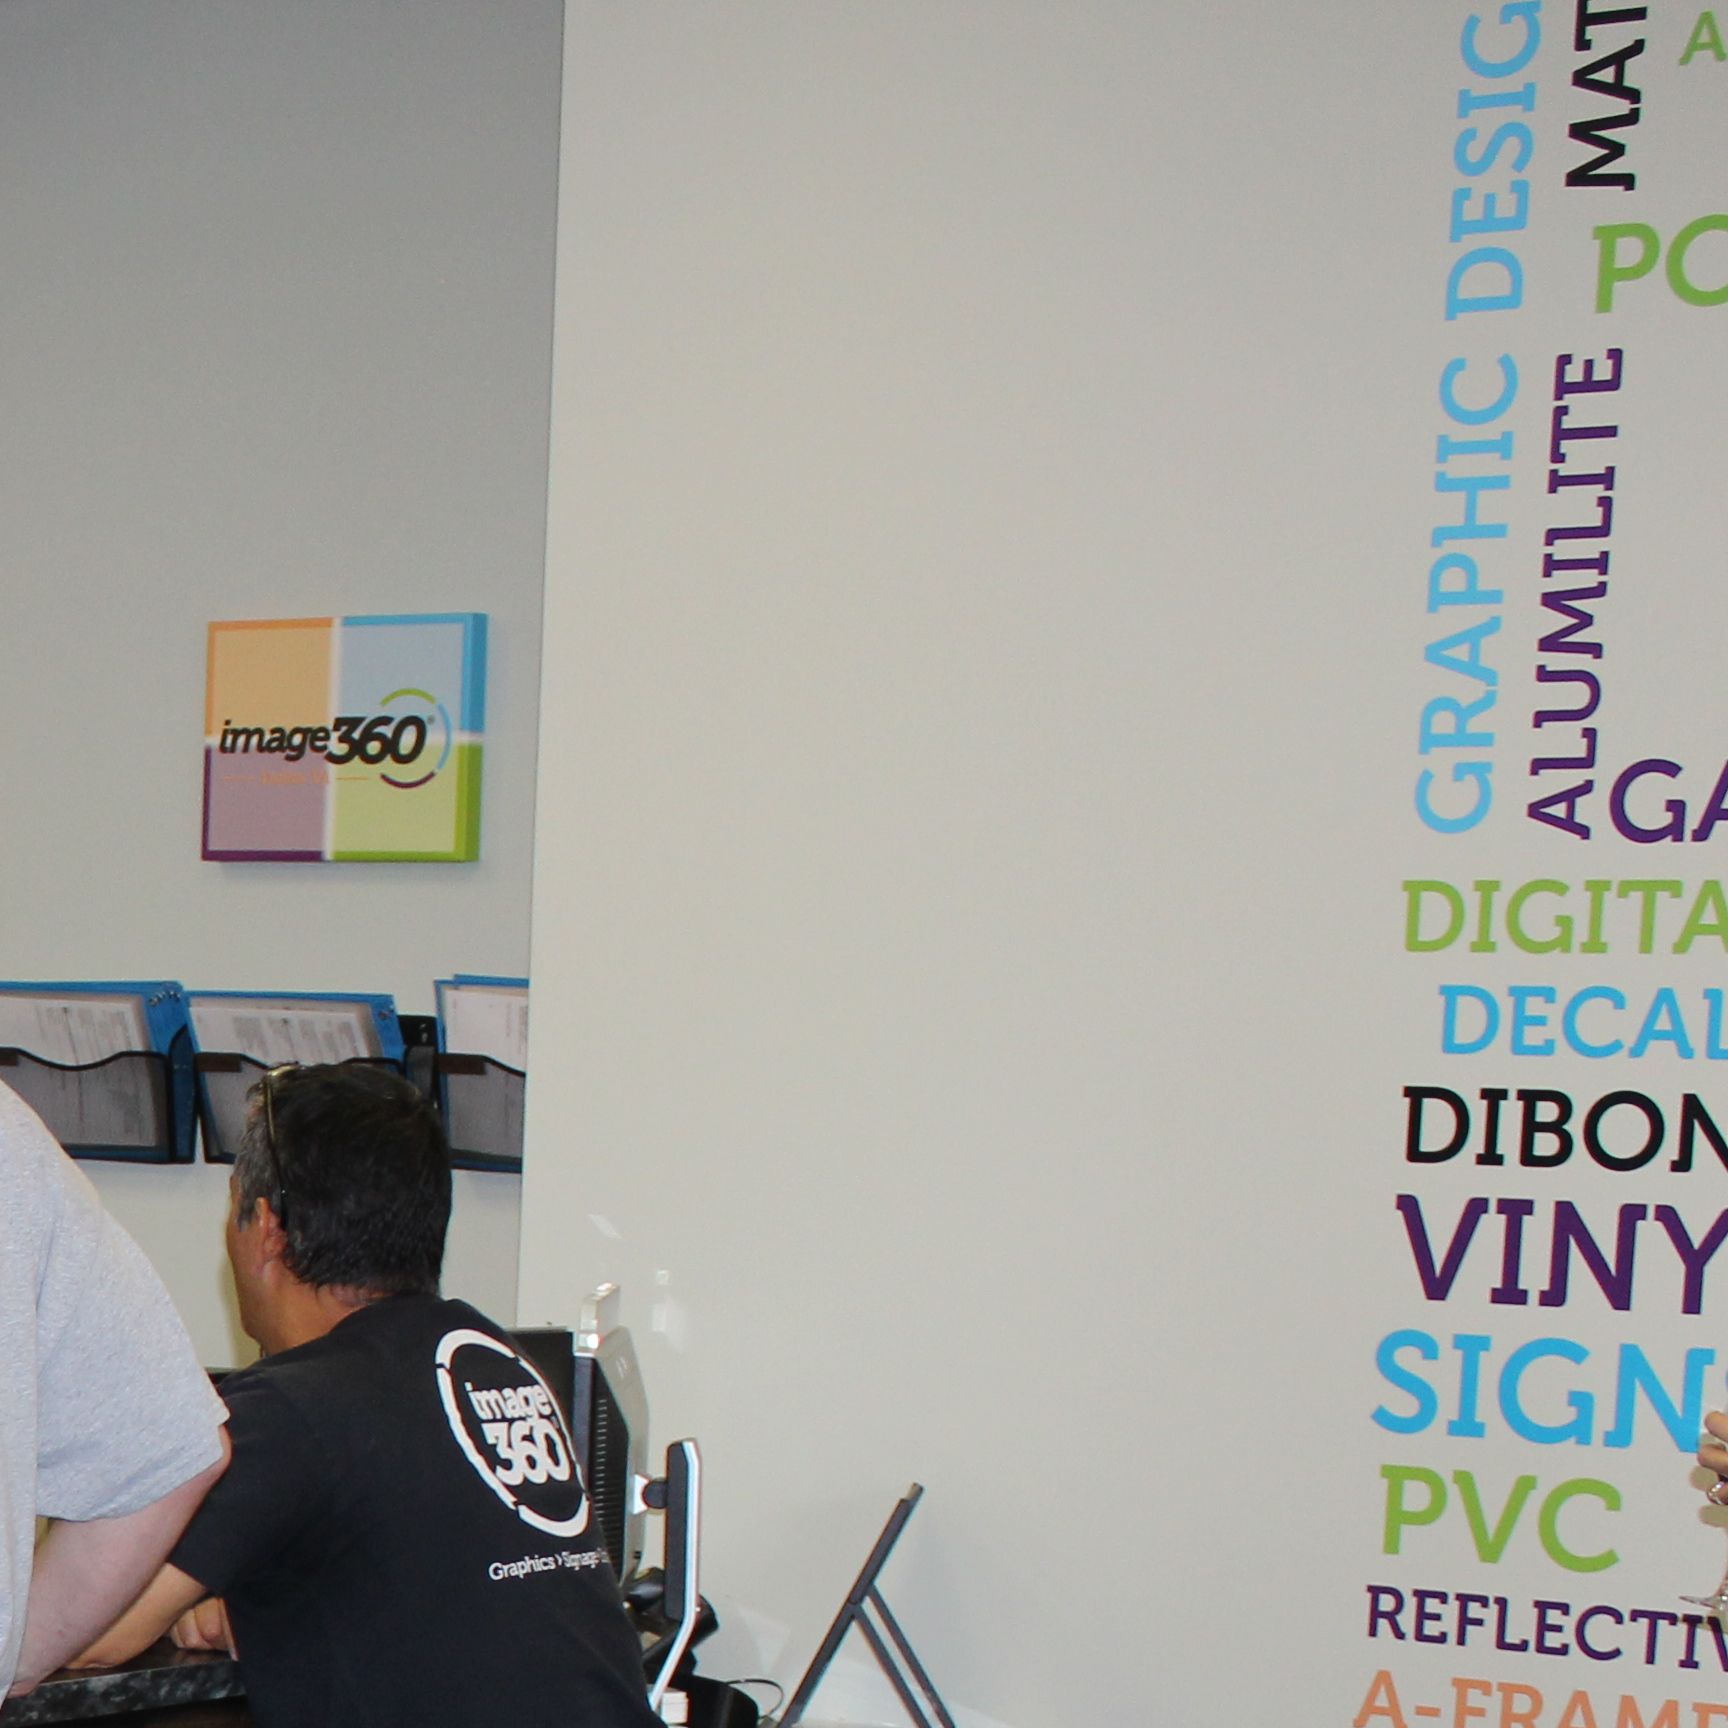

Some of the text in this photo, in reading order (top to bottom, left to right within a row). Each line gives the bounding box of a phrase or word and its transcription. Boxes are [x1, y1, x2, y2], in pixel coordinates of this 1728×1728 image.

[1564, 0, 1648, 191] MAT
[1414, 0, 1542, 835] GRAPHIC DESIG
[1527, 347, 1623, 840] ALUMILITE
[1401, 877, 1728, 955] DIGITA
[1438, 984, 1728, 1060] DECAL
[1402, 1085, 1728, 1173] DIBON
[1395, 1193, 1728, 1315] VINY
[464, 1381, 552, 1422] image
[1370, 1328, 1728, 1453] SIGN
[480, 1417, 572, 1486] 360
[488, 1554, 557, 1580] Graphics
[1380, 1463, 1623, 1574] PVC
